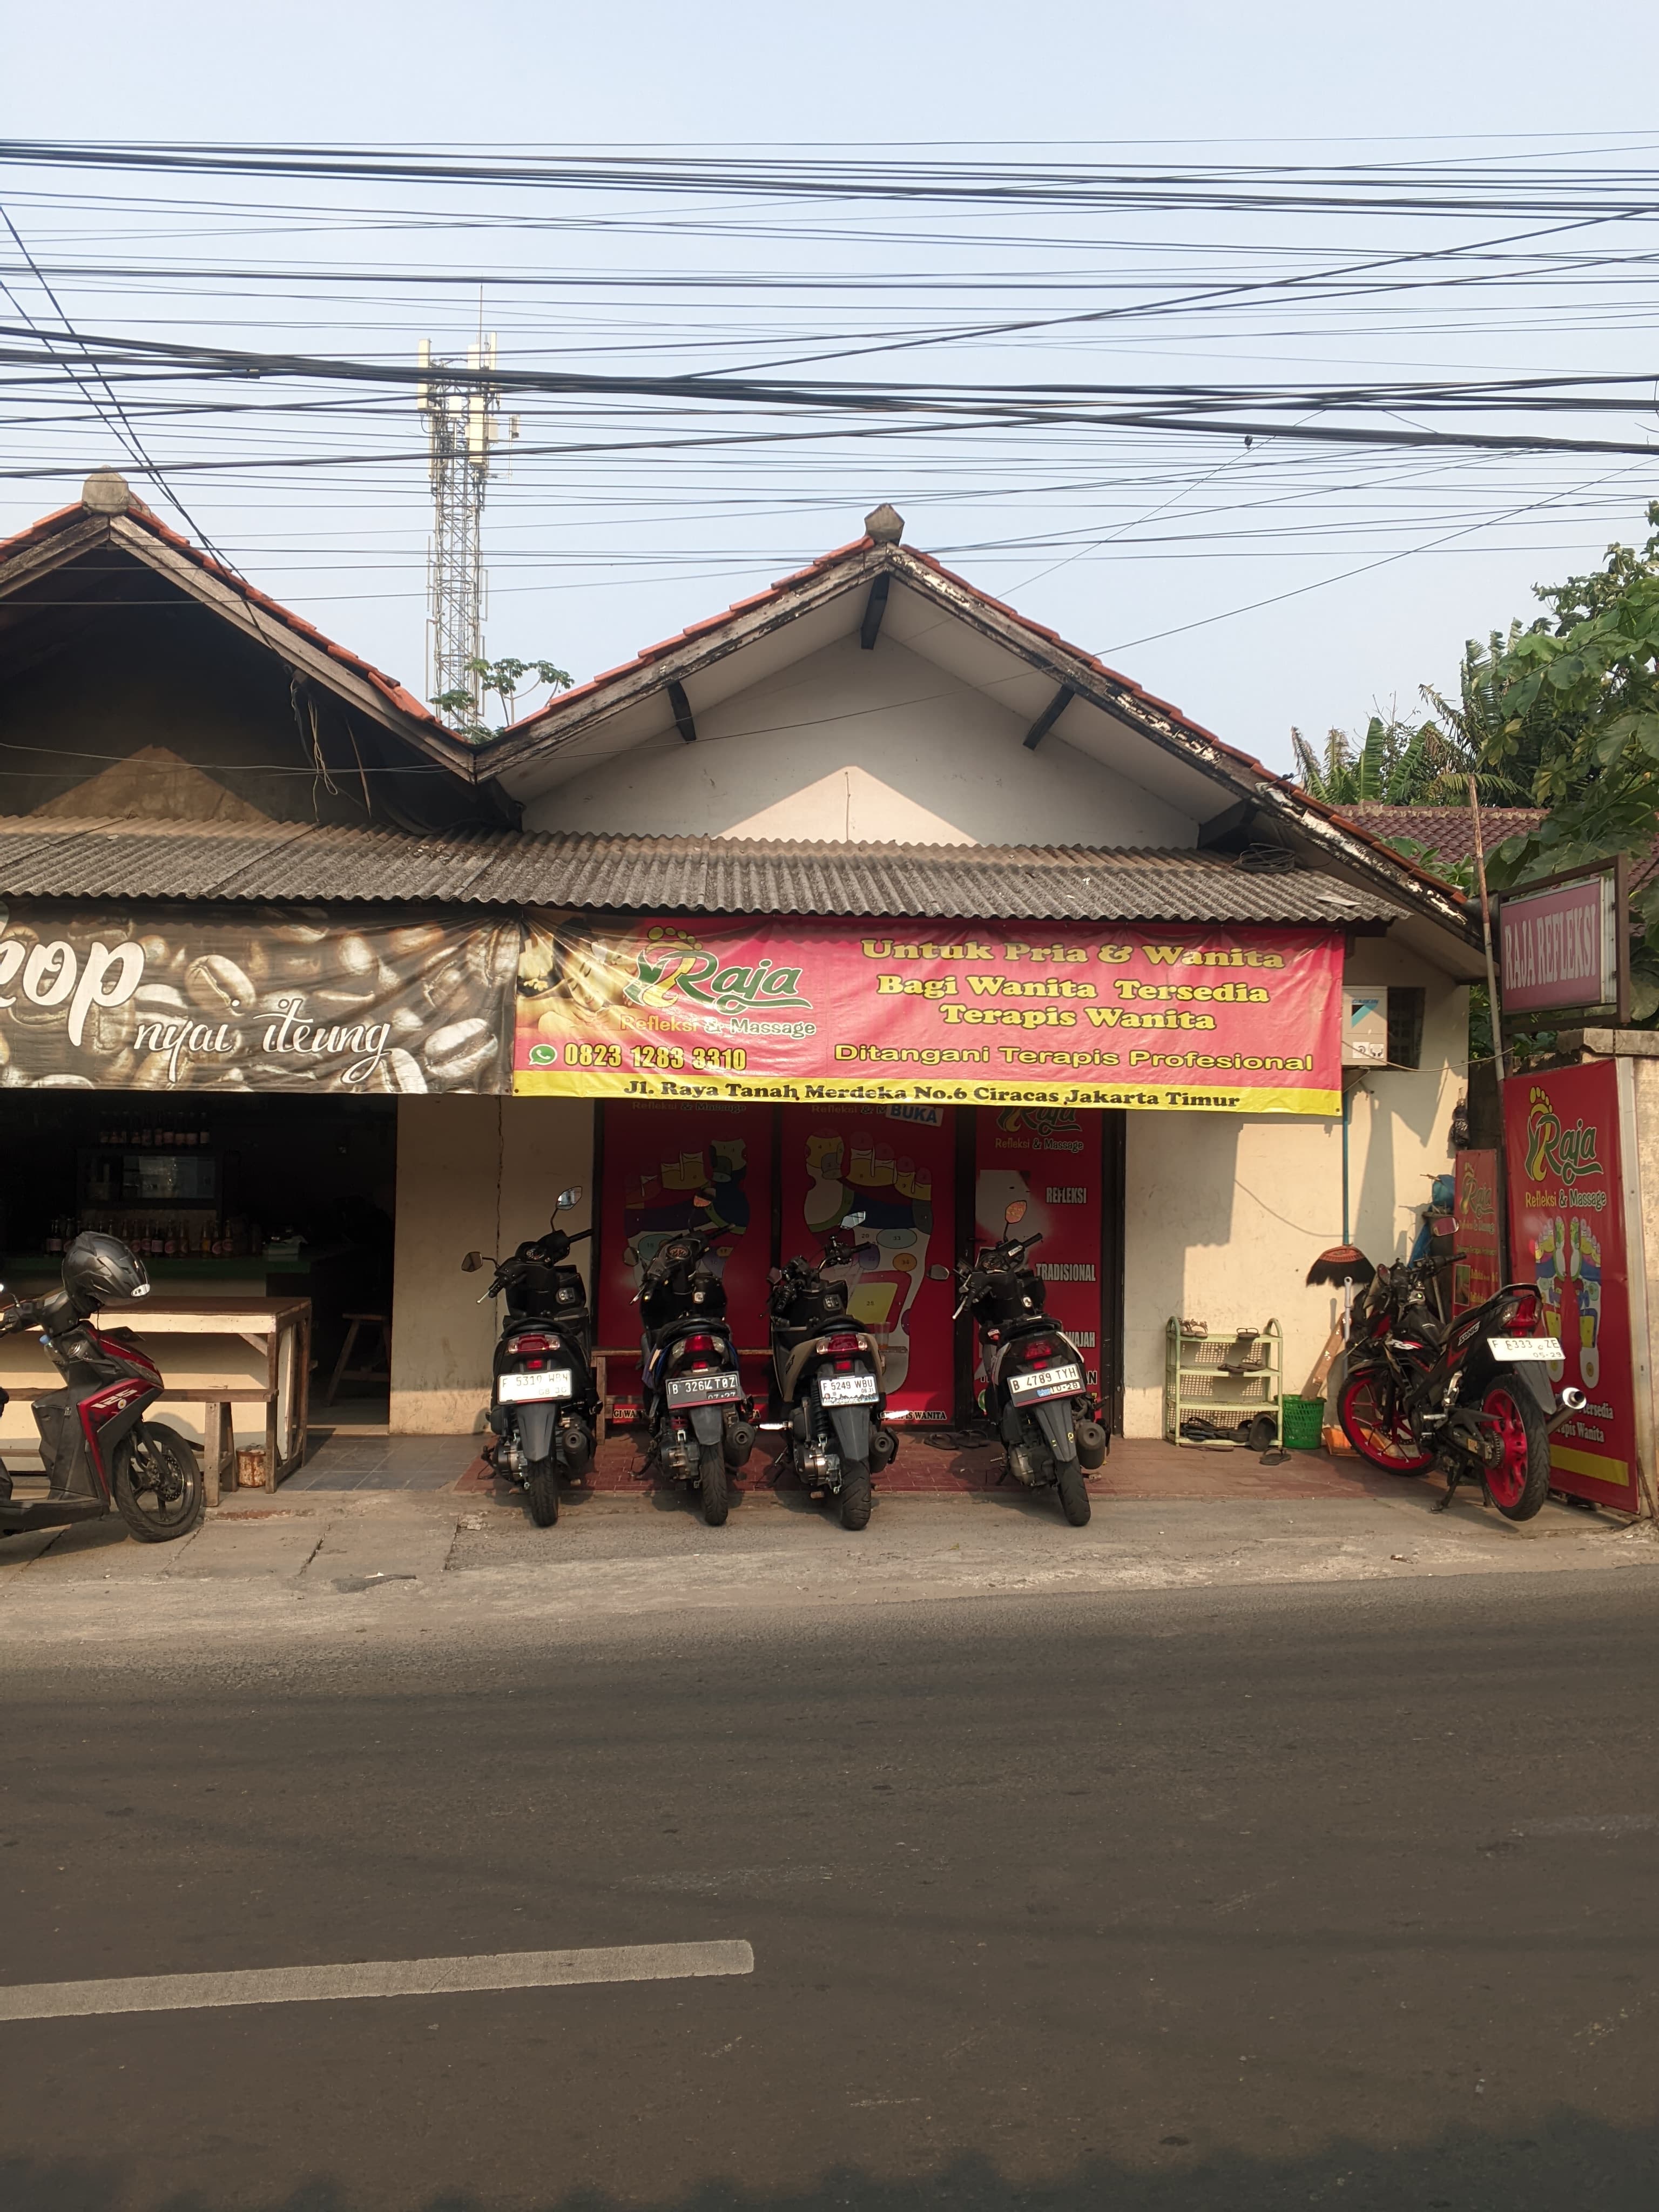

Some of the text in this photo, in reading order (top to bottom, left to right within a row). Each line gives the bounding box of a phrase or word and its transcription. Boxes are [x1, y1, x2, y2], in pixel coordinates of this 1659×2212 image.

[861, 939, 1285, 968] Untuk Pria & Wanita
[1505, 903, 1596, 989] RAJA REFLEKSI
[652, 948, 813, 1015] Raja
[876, 975, 1270, 1003] Bagi Wanita Tersedia
[621, 1014, 817, 1040] Refleksi & Massage
[939, 1003, 1216, 1030] Terapis Wanita
[133, 999, 393, 1083] nyai iteung
[564, 1043, 747, 1071] 0823 1283 3310
[834, 1044, 1314, 1071] Ditangani Terapis Profesional
[624, 1081, 655, 1095] Jl.
[660, 1081, 719, 1098] Raya
[804, 1085, 908, 1100] Merdeka
[913, 1086, 968, 1100] No.6
[1064, 1089, 1164, 1105] Jakarta
[1165, 1091, 1240, 1107] Timur
[891, 1104, 938, 1124] BUKA
[1043, 1138, 1084, 1154] Massage
[1535, 1112, 1604, 1186] Raja
[1046, 1186, 1087, 1204] REFLEKSI
[1525, 1188, 1607, 1212] Refleksi & Massage
[1036, 1263, 1096, 1282] TRADISIONAL
[1458, 1321, 1481, 1346] SONIC
[672, 1384, 678, 1395] B
[822, 1379, 873, 1391] F 5249 WBU
[1012, 1380, 1020, 1391] B
[1027, 1373, 1052, 1386] 4789
[1055, 1367, 1076, 1380] TYH
[91, 1388, 138, 1408] 125
[914, 1410, 947, 1421] WANITA
